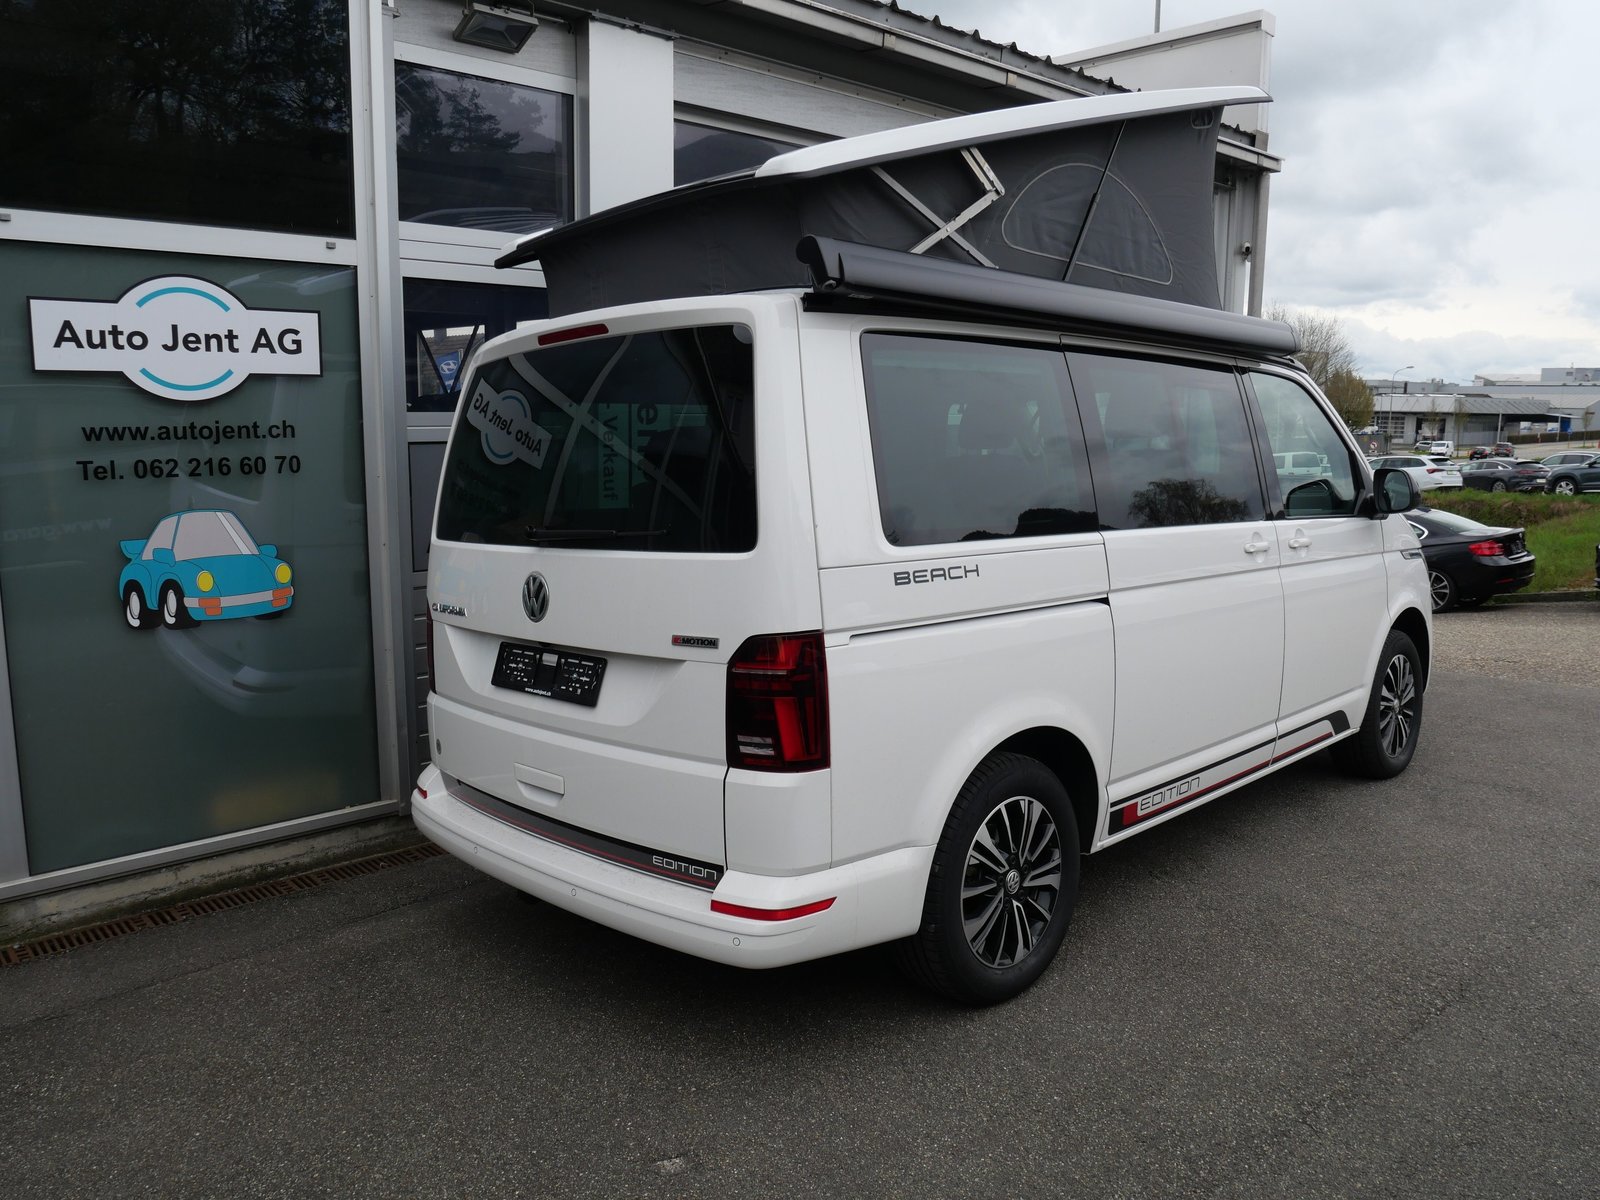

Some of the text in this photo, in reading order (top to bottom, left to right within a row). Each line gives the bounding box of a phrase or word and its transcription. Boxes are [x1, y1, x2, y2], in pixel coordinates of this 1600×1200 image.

[53, 319, 303, 355] Auto Jent AG
[81, 420, 296, 445] www.autojent.ch
[76, 454, 301, 481] Tel. 062 216 60 70
[893, 564, 980, 586] BEACH
[673, 636, 717, 647] 4MOTION
[1140, 777, 1200, 811] EDITION
[652, 855, 717, 881] EDITION
